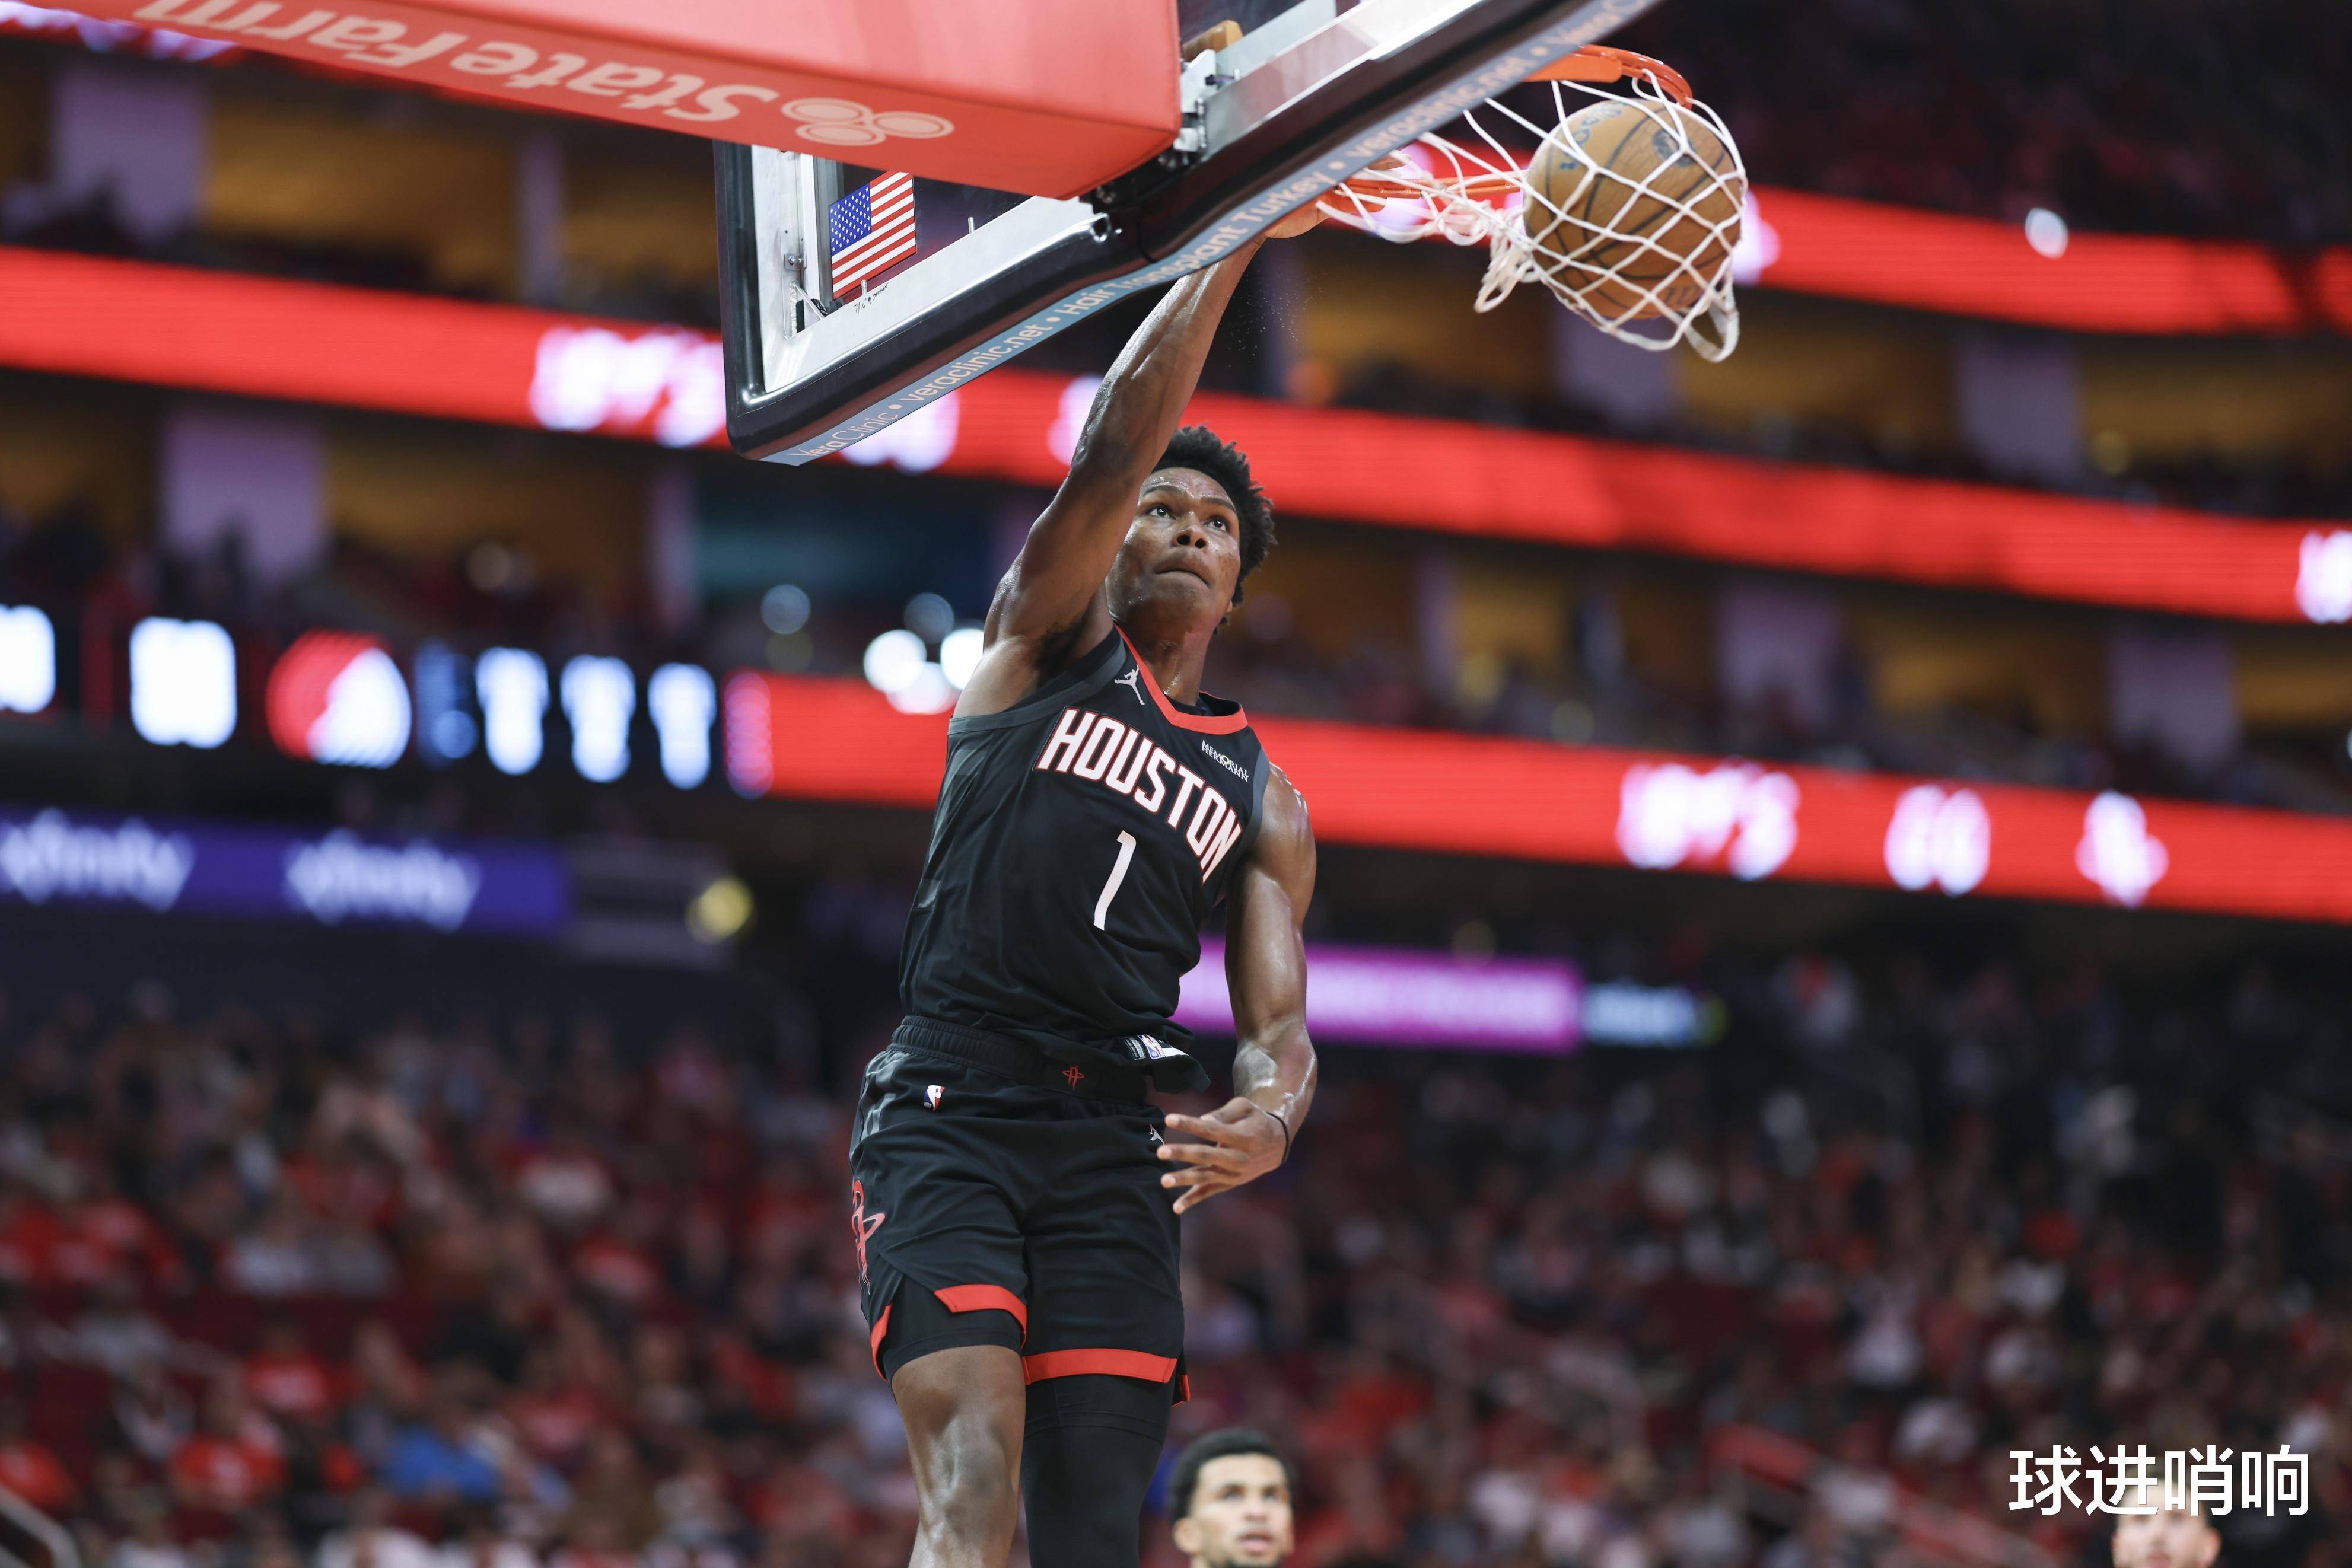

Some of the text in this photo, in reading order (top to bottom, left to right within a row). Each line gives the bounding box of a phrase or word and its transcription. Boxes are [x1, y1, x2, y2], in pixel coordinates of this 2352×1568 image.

[787, 412, 899, 457] VeraClinic
[900, 323, 1052, 403] veraclinic.net
[1058, 286, 1116, 315] Hair
[1104, 225, 1249, 289] Transplant
[1230, 171, 1337, 223] Turkey
[1034, 706, 1243, 885] HOUSTON
[1093, 830, 1137, 931] 1
